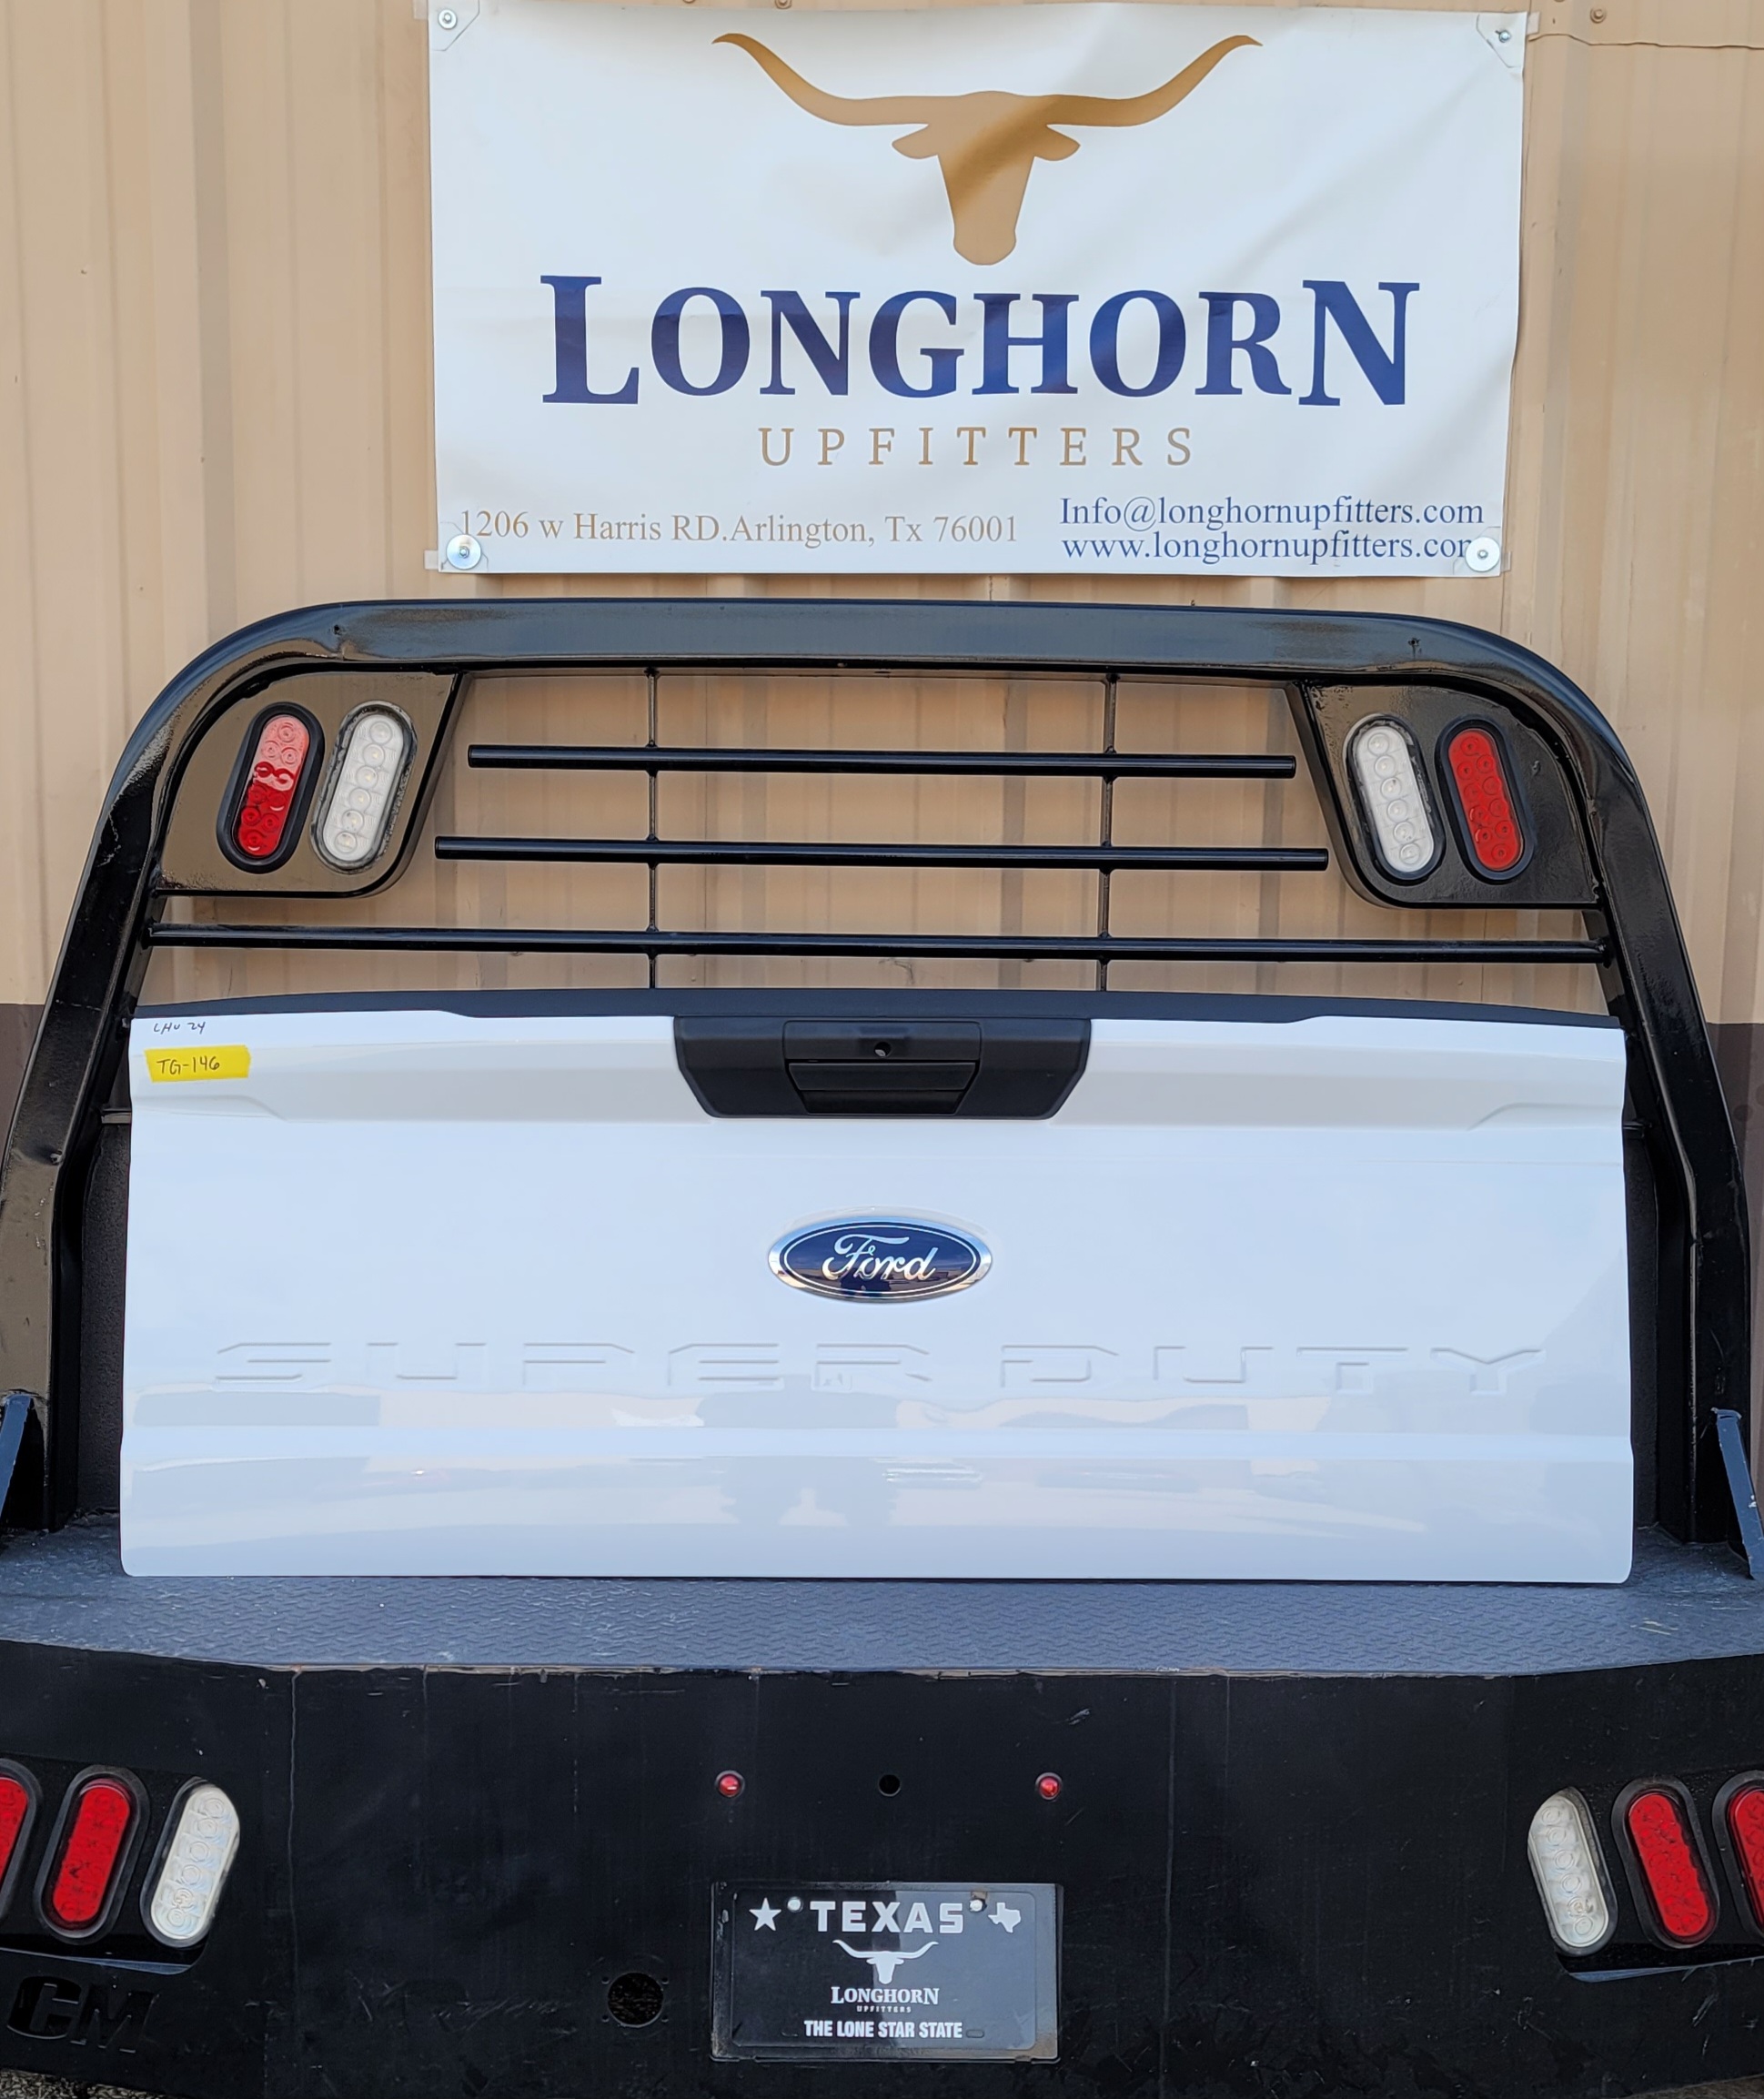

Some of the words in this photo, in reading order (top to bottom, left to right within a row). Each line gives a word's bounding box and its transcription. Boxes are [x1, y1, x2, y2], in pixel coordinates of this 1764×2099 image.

[540, 275, 1420, 406] LONGHORN
[759, 427, 1193, 466] UPFITTERS
[461, 510, 529, 538] 1206
[539, 519, 564, 540] w
[573, 512, 661, 540] Harris
[884, 515, 923, 542] Tx
[933, 515, 1018, 542] 76001
[1059, 495, 1485, 532] Info@longhornupfitters.com
[156, 1055, 220, 1075] TG-146
[822, 1234, 939, 1281] Ford
[215, 1342, 932, 1391] SUPER
[1001, 1345, 1546, 1395] DUTY
[810, 1901, 964, 1934] TEXAS
[830, 1986, 940, 2005] LONGHORN
[856, 2004, 912, 2013] UPFITTERS
[804, 2020, 833, 2037] THE
[836, 2021, 875, 2038] LONE
[878, 2021, 915, 2038] STAR
[919, 2022, 963, 2039] STATE
